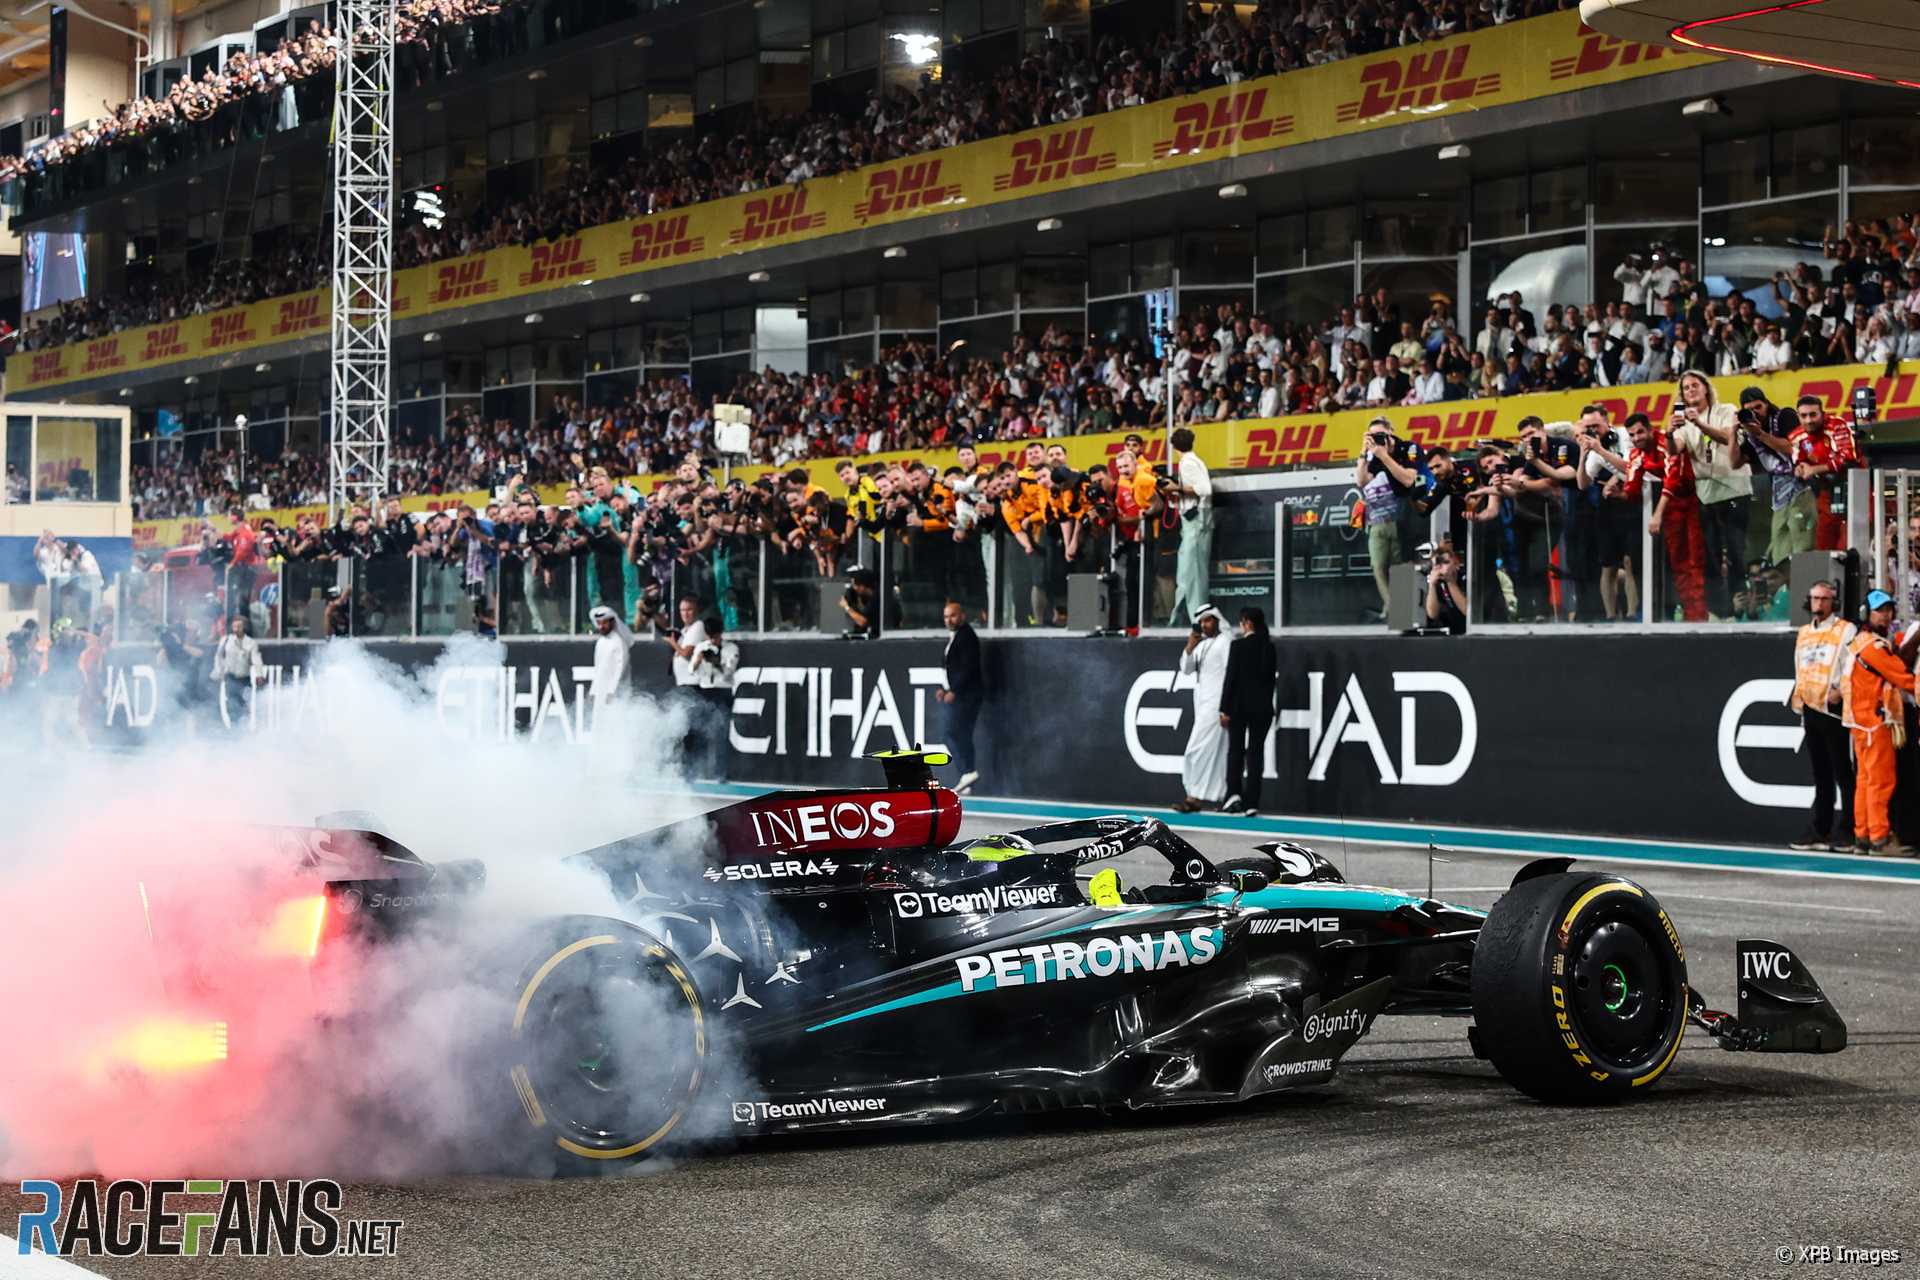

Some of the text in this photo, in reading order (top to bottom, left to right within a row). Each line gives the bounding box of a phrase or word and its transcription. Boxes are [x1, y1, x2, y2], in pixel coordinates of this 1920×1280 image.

[1357, 44, 1478, 119] DHL
[1172, 88, 1274, 154] DHL
[1009, 126, 1099, 188] DHL
[868, 159, 945, 216] DHL
[743, 190, 811, 243] DHL
[630, 215, 691, 264] DHL
[437, 259, 488, 302] DHL
[530, 239, 586, 284] DHL
[209, 311, 250, 347] DHL
[280, 295, 321, 335] DHL
[87, 338, 120, 373] DHL
[144, 326, 182, 360] DHL
[32, 351, 63, 383] DHL
[1246, 424, 1331, 468] DHL
[1124, 670, 1478, 786] EHAD
[750, 800, 895, 847] INEOS
[723, 860, 823, 880] SOLERA
[921, 884, 1057, 914] TeamViewer
[1273, 917, 1340, 933] AMG
[955, 927, 1216, 992] PETRONAS
[1742, 951, 1792, 980] IWC
[1266, 1059, 1333, 1079] CROWDSTRIKE
[756, 1097, 887, 1120] TeamViewer
